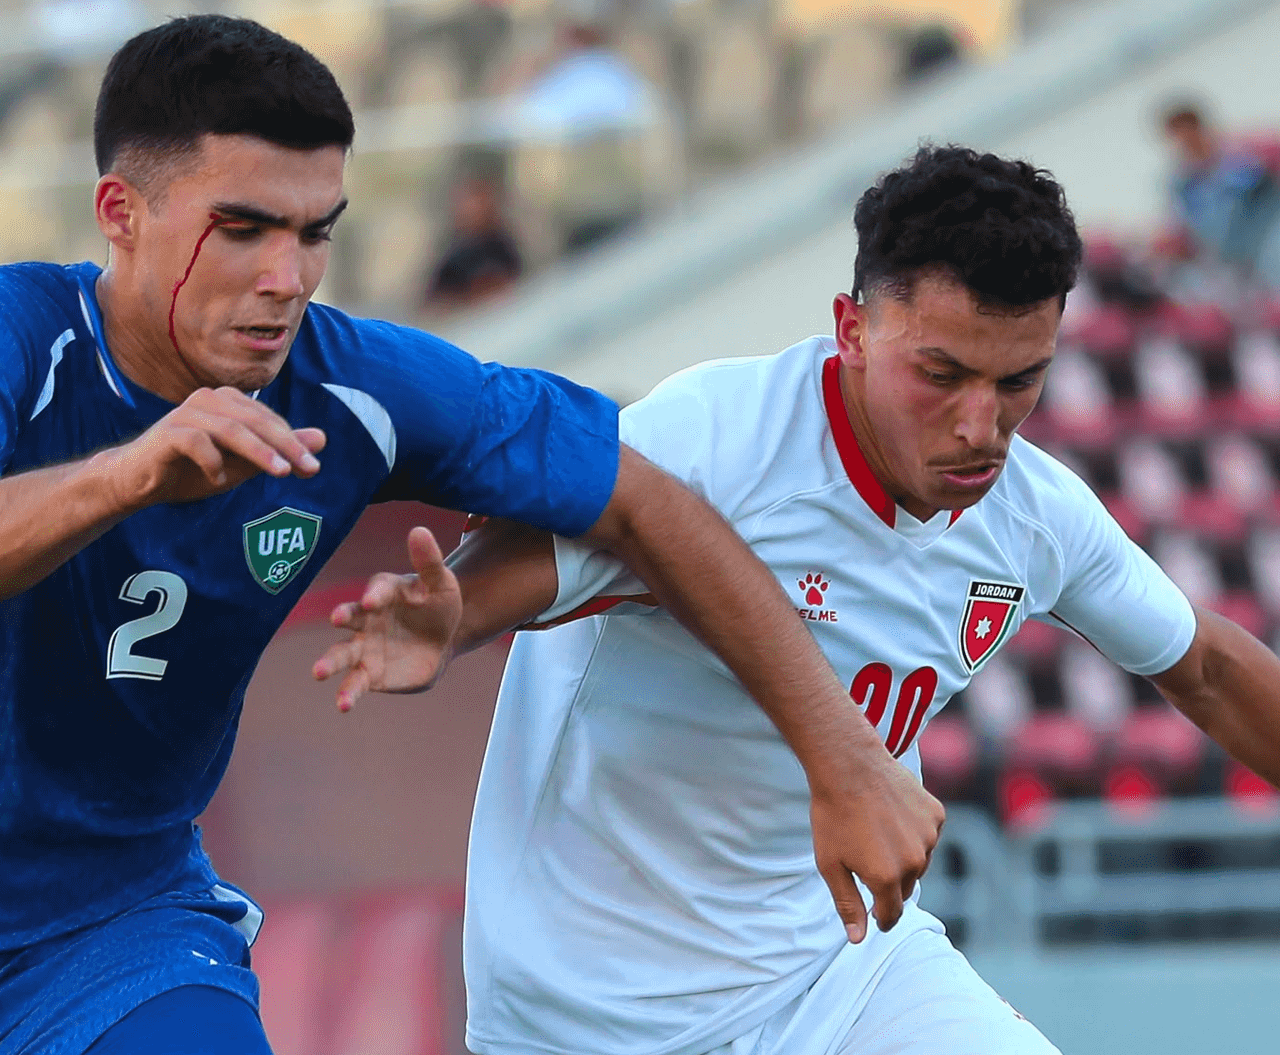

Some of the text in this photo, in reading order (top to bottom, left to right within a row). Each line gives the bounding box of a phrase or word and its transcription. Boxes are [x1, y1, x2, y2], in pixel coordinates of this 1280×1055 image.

[258, 526, 305, 556] UFA
[975, 584, 1017, 599] JORDAN
[106, 570, 188, 681] 2
[795, 608, 838, 622] ELME
